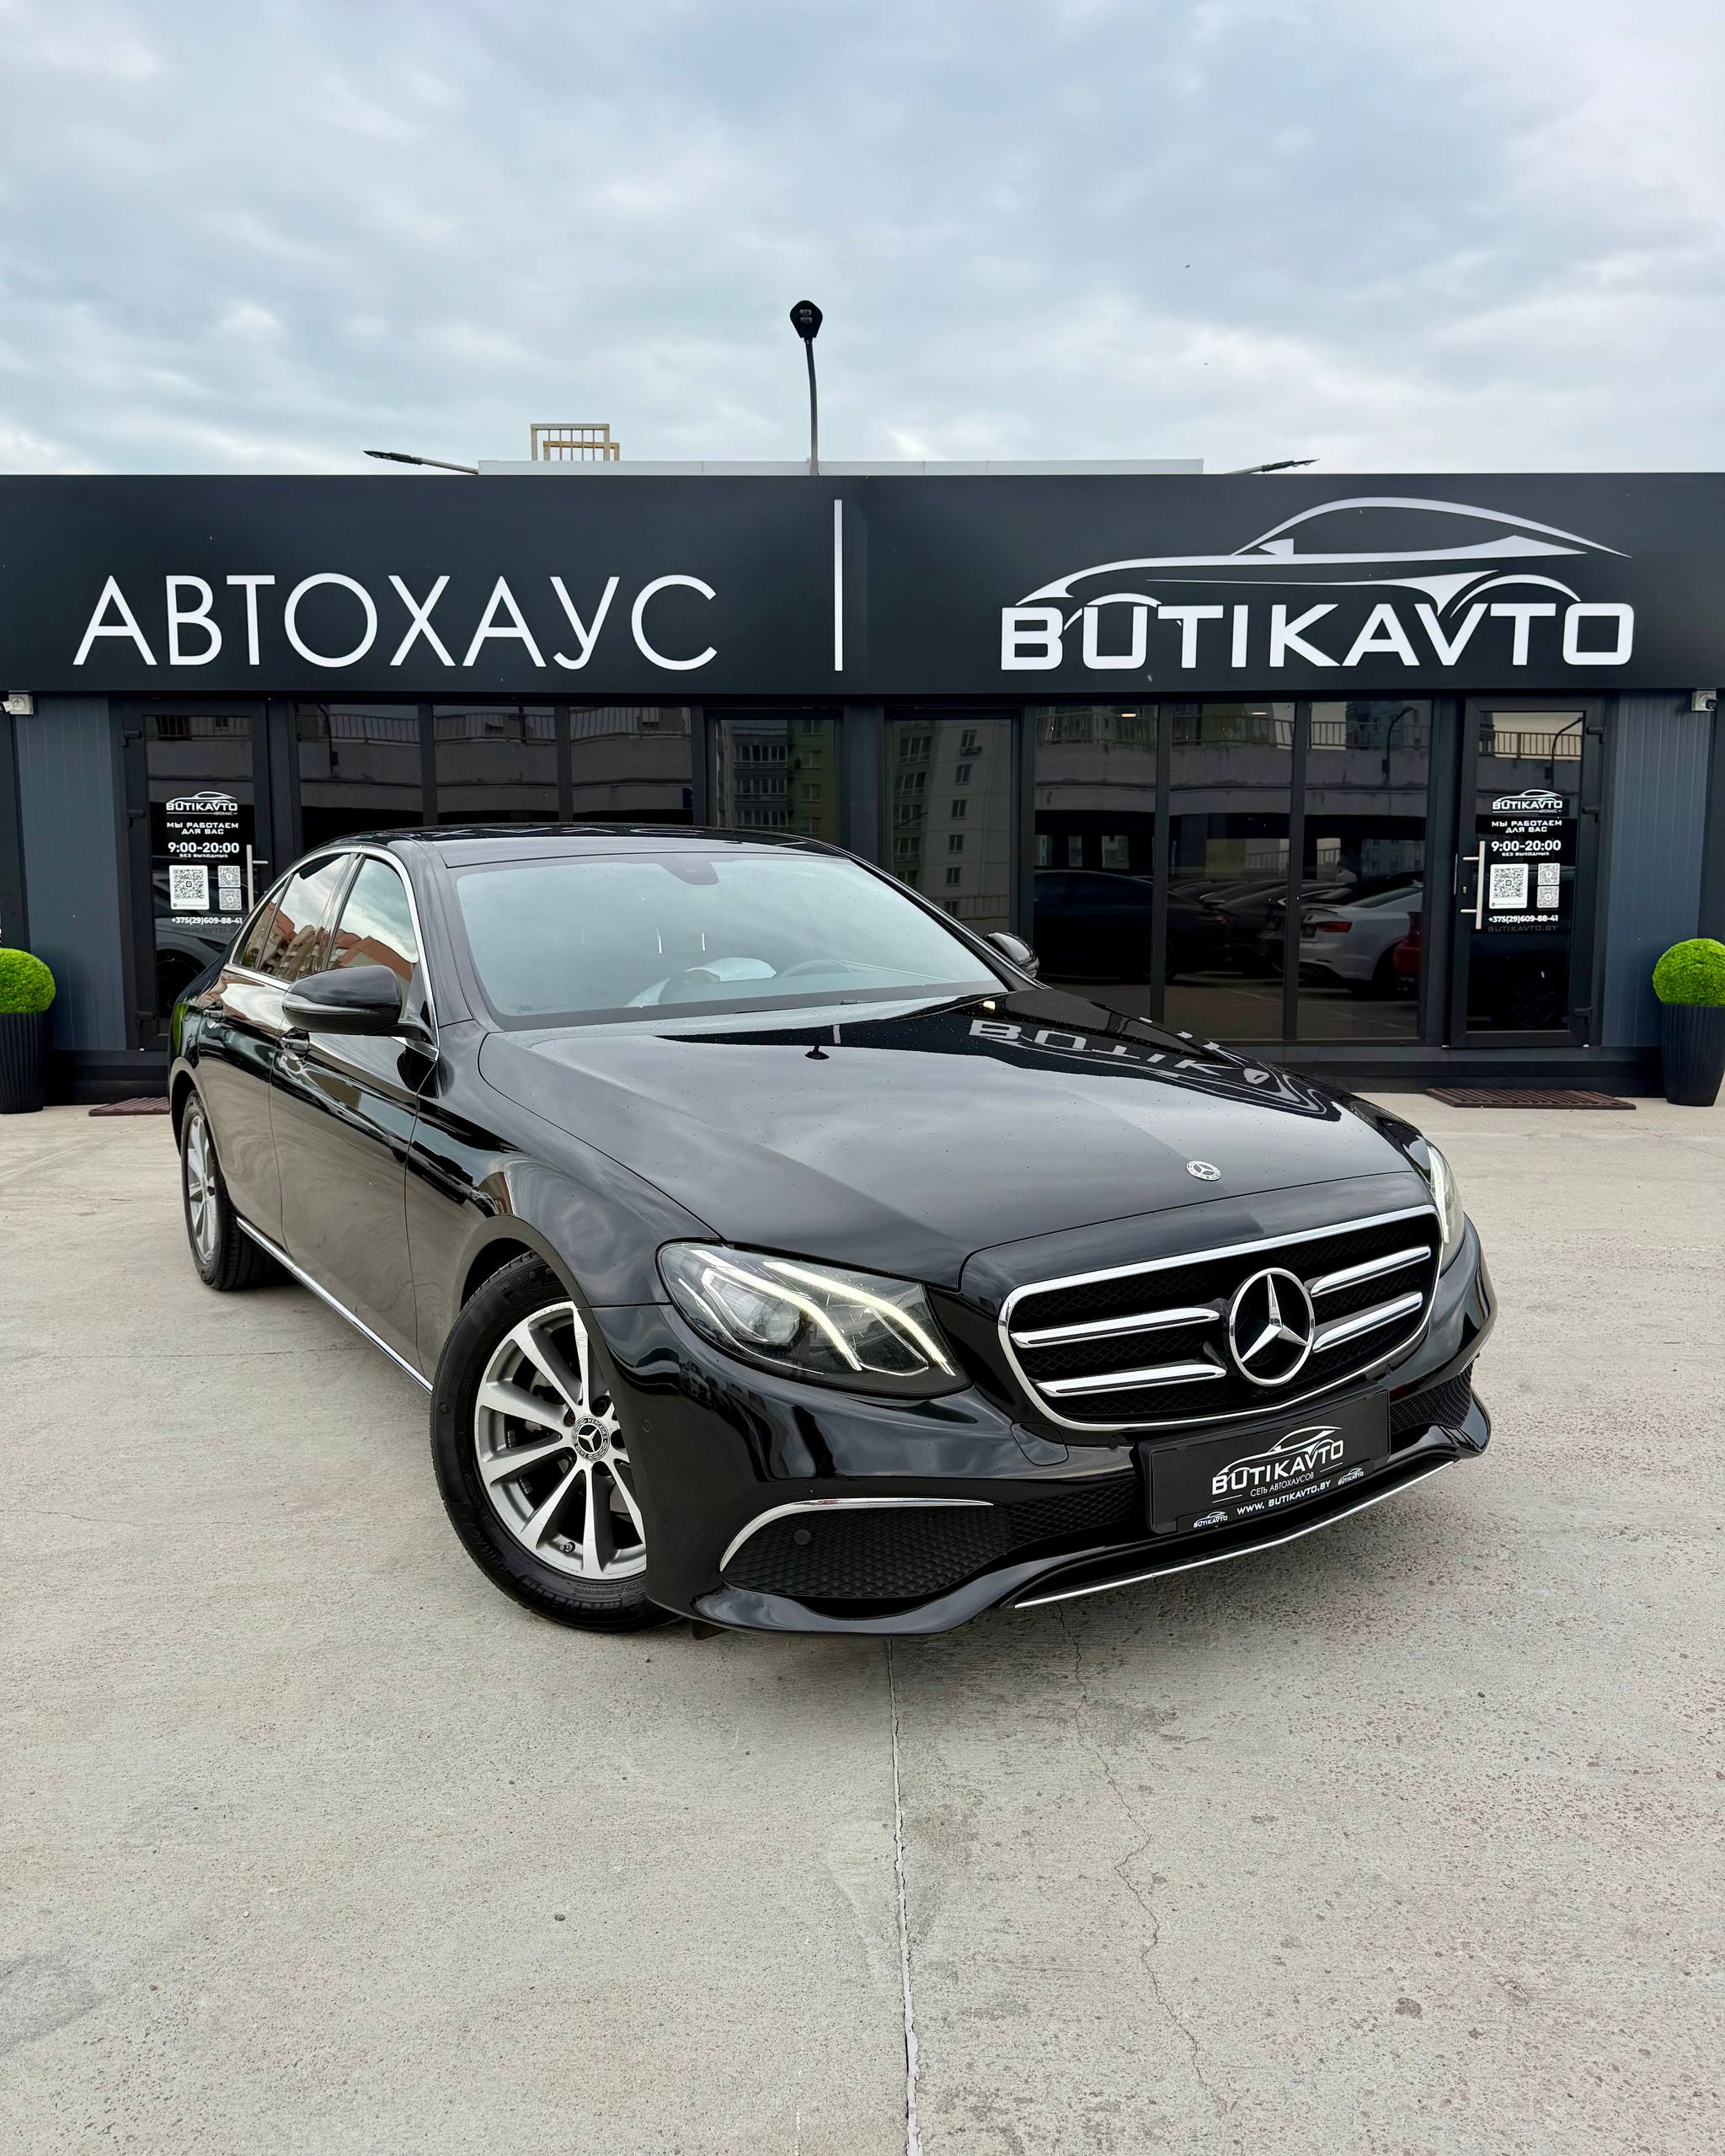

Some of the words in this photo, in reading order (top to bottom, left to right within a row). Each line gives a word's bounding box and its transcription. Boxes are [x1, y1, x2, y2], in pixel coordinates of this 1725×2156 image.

[72, 573, 718, 671] АВТОХАУС
[1001, 601, 1634, 670] BUTIKAVTO
[166, 802, 238, 811] BUTIKAVTO
[1492, 799, 1563, 809] BUTIKAVTO
[168, 841, 240, 854] 9:00-20:00
[1491, 840, 1562, 852] 9:00-20:00
[171, 916, 243, 926] +375(29)609-88-41
[1487, 915, 1559, 924] +375(29)609-88-41
[1211, 1439, 1344, 1496] BUTIKAVTO
[1250, 1486, 1268, 1497] СЕТЬ
[1268, 1471, 1315, 1492] АВТОХАУСОВ
[1236, 1502, 1265, 1515] WWW.
[1268, 1480, 1332, 1508] BUTIKAVTO.BY
